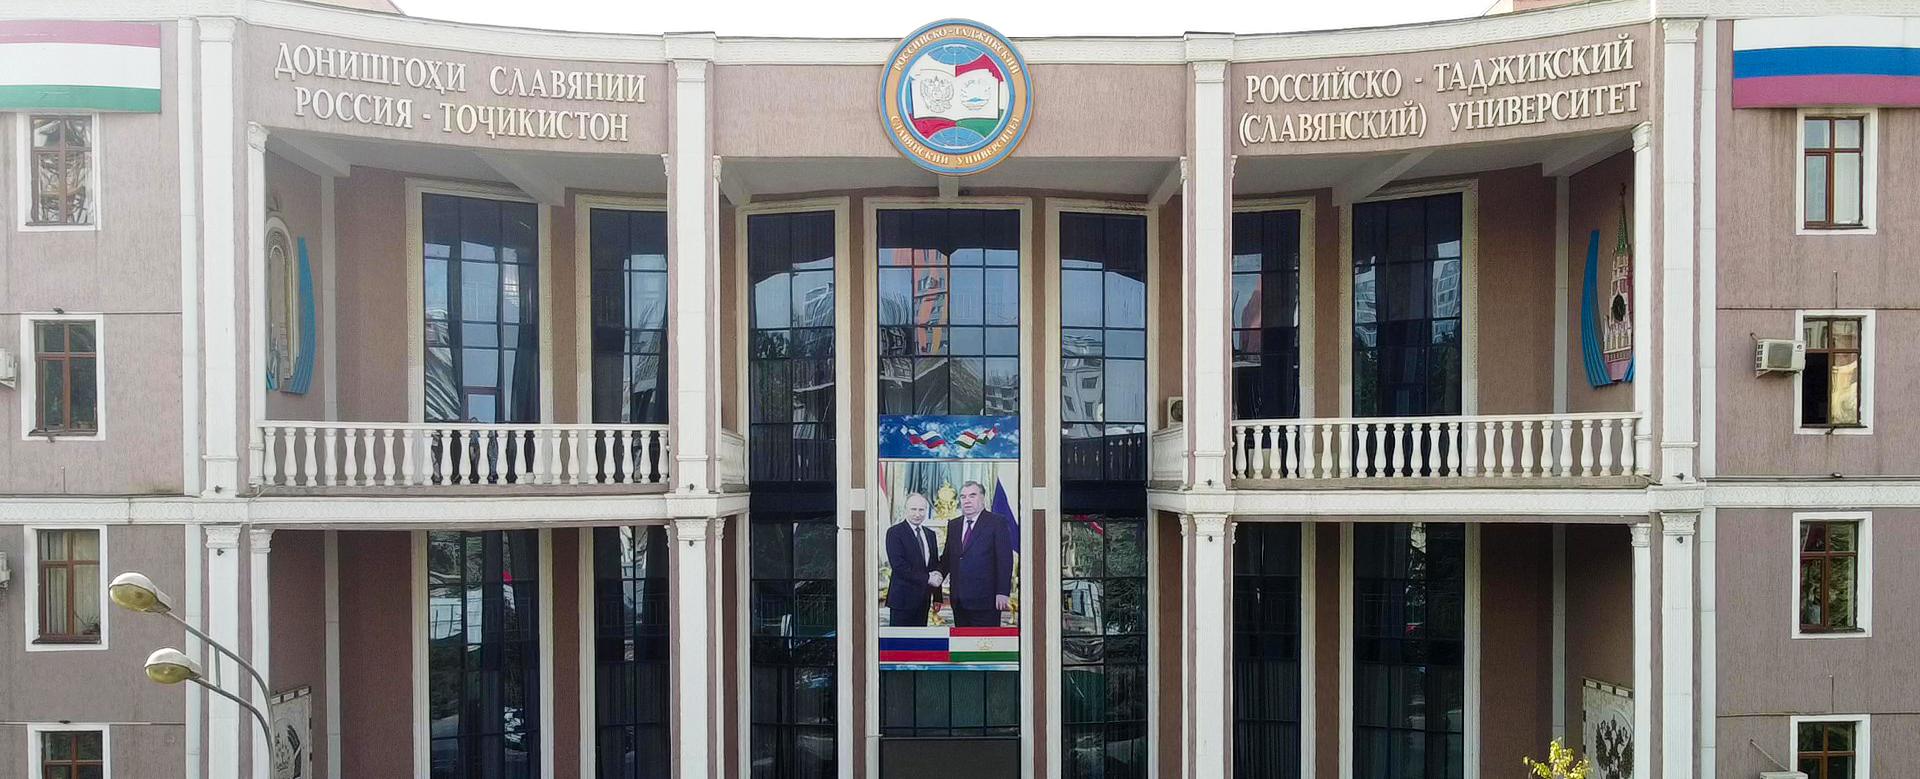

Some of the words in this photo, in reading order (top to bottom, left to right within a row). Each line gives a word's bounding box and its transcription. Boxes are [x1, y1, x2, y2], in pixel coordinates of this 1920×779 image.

[489, 65, 646, 103] СЛАВЯНИИ
[1245, 66, 1402, 104] РОССИЙСКО
[1433, 33, 1635, 95] ТАДЖИКСКИЙ
[295, 86, 413, 129] РОССИЯ
[1239, 100, 1427, 147] (СЛАВЯНСКИЙ)
[1448, 81, 1642, 131] УНИВЕРСИТЕТ
